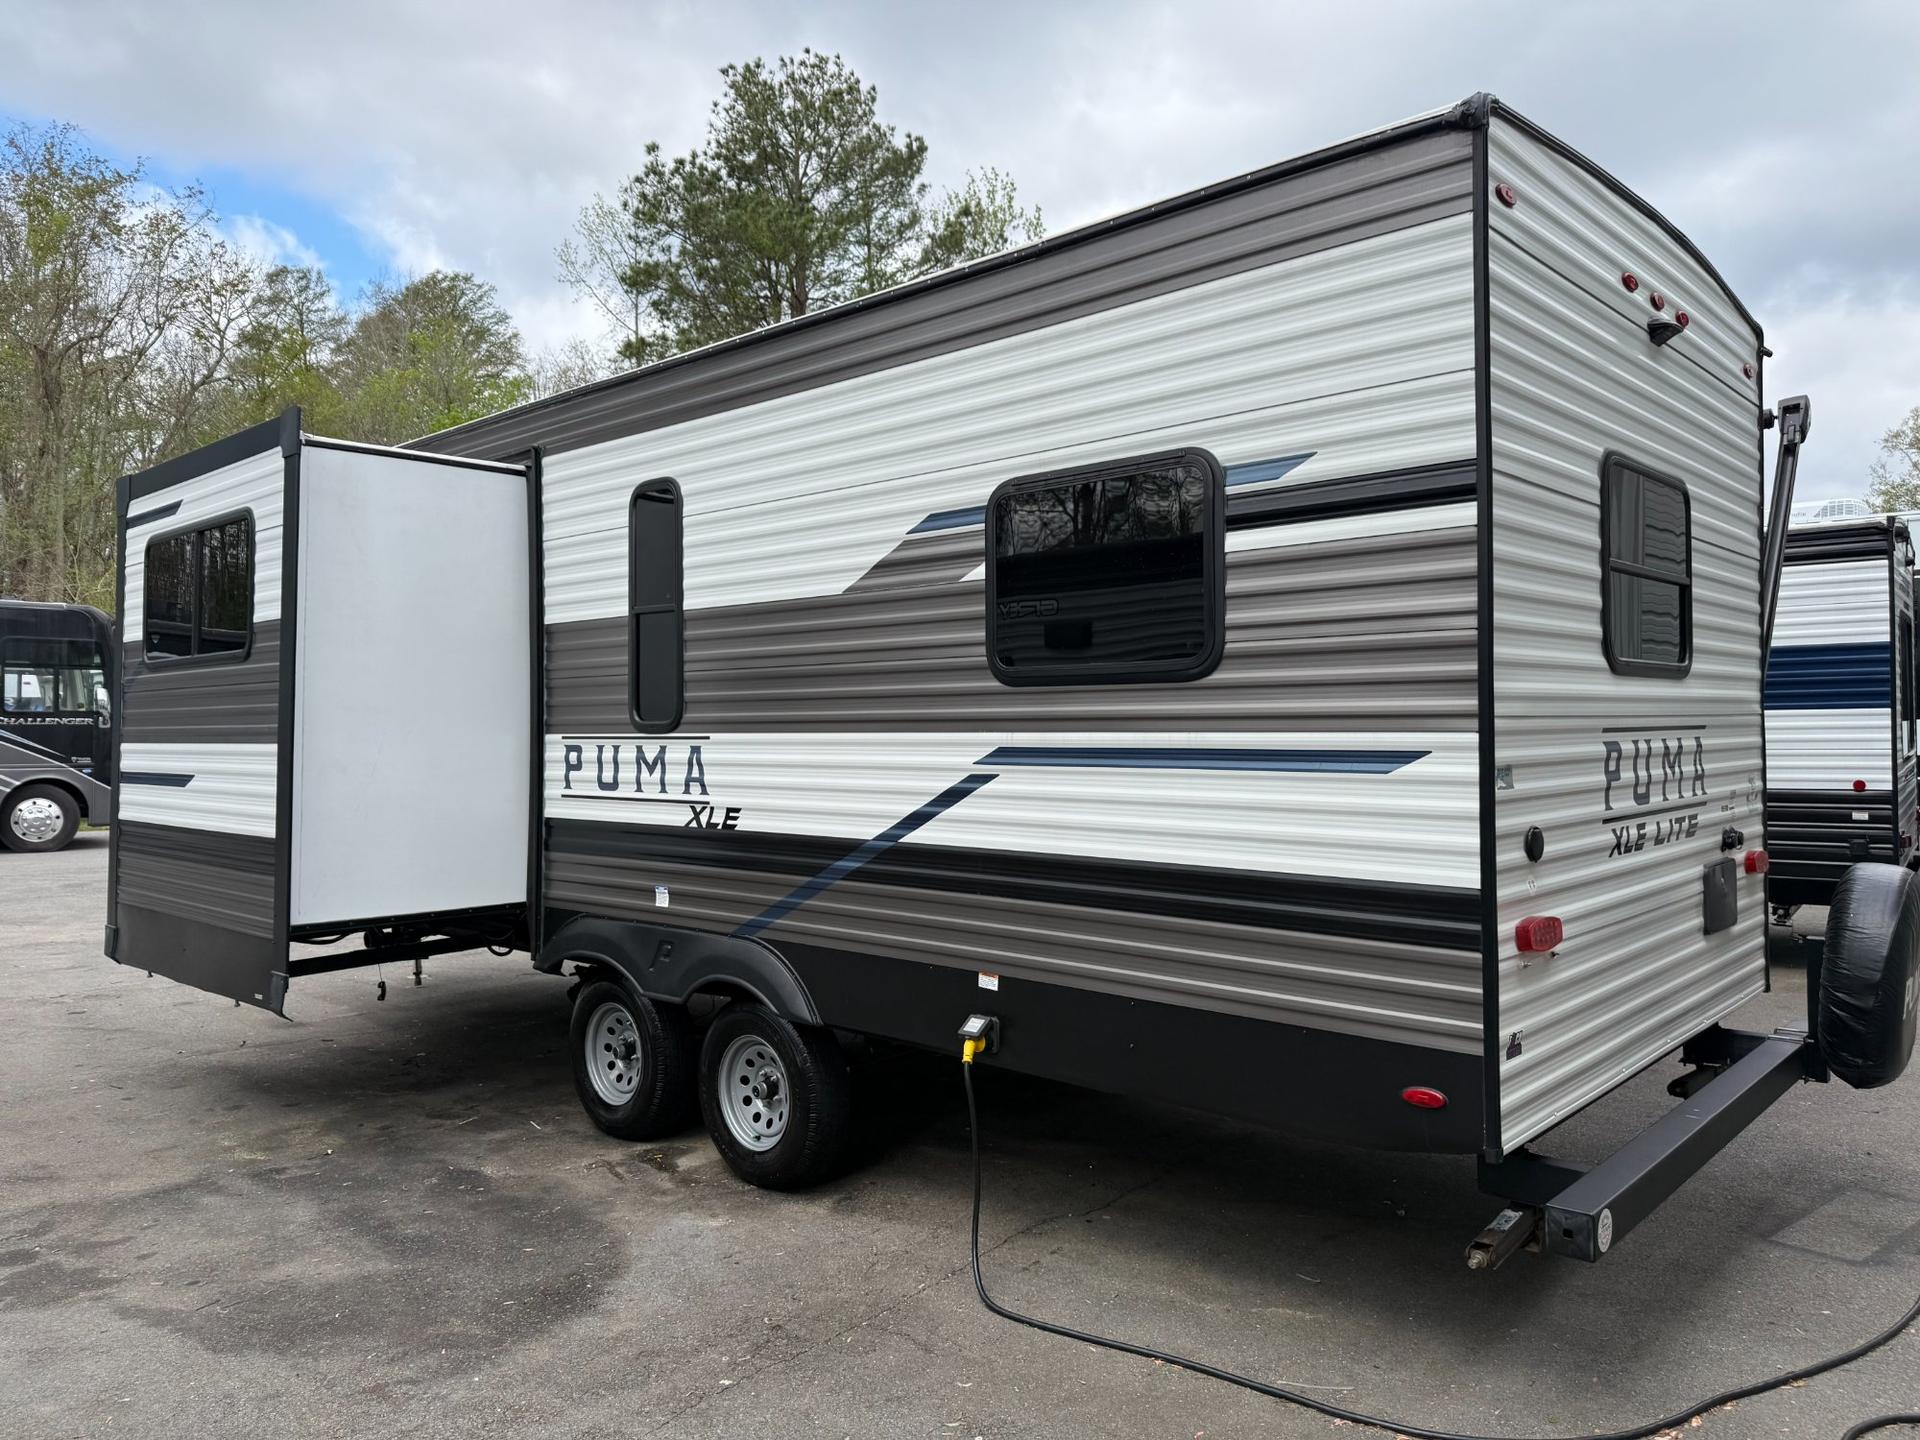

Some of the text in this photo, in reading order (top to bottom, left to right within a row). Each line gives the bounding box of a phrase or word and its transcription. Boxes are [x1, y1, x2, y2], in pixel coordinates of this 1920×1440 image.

[563, 744, 710, 796] PUMA
[1602, 735, 1709, 811] PUMA
[684, 805, 742, 831] XLE
[1608, 813, 1699, 858] XLE LITE
